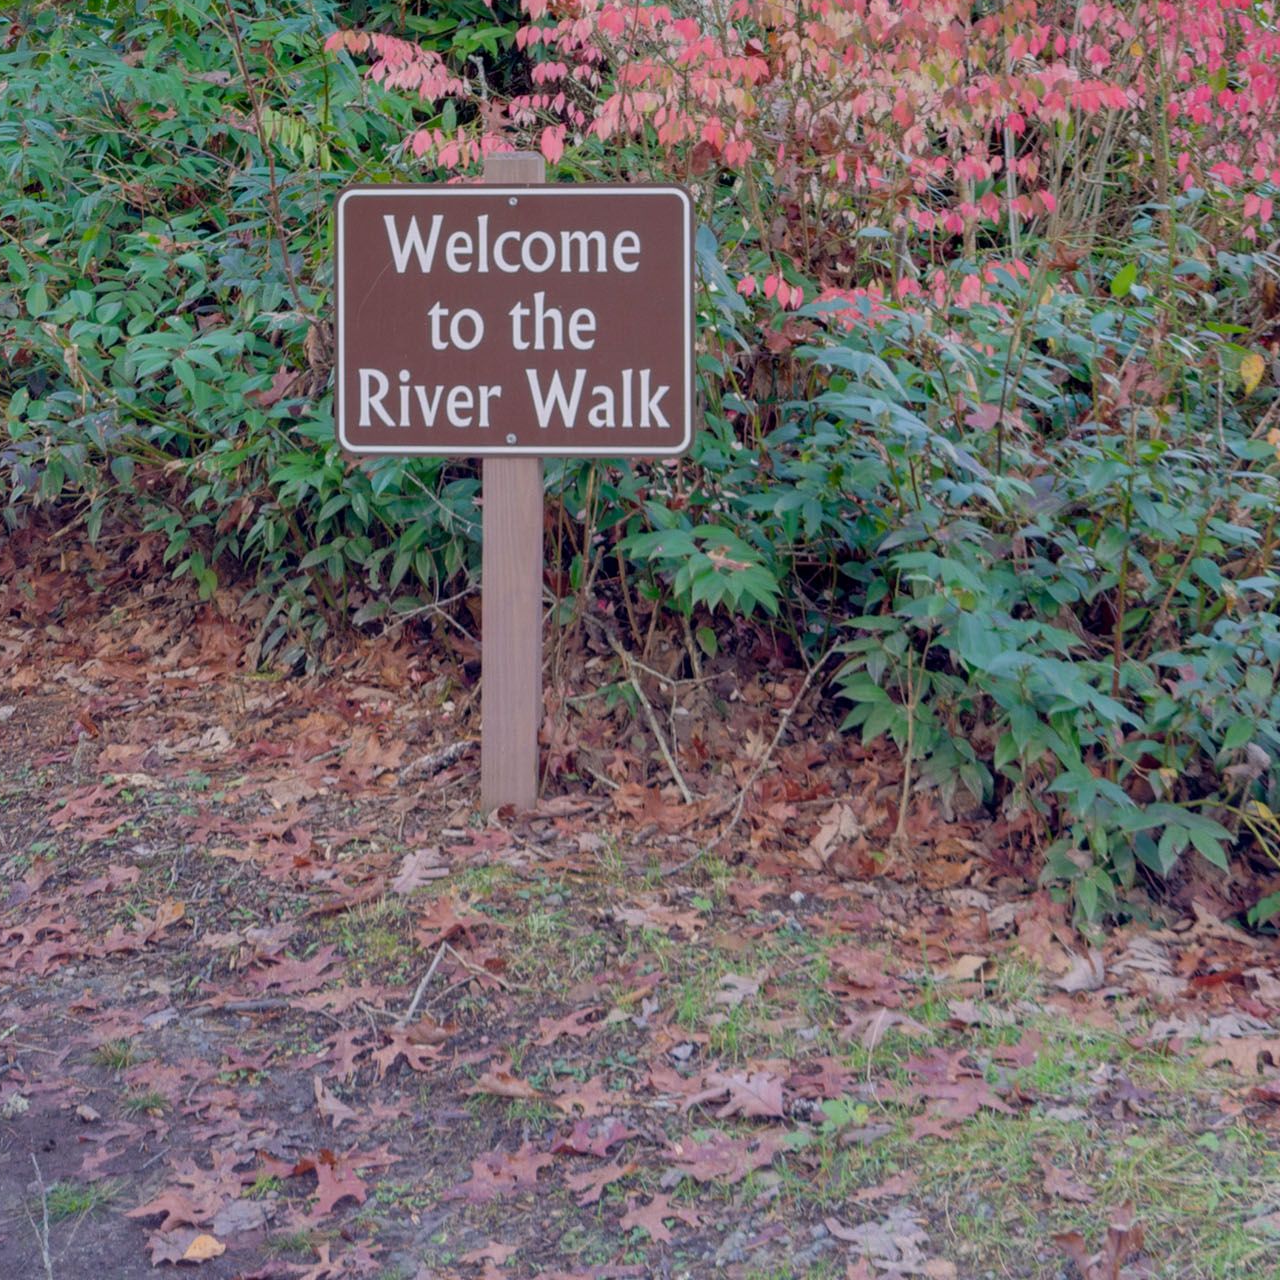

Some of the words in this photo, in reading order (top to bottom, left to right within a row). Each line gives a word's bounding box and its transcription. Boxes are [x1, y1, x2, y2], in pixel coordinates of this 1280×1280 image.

[383, 214, 641, 274] Welcome
[427, 301, 485, 351] to
[508, 291, 597, 351] the
[358, 368, 502, 428] River
[525, 368, 671, 429] Walk
